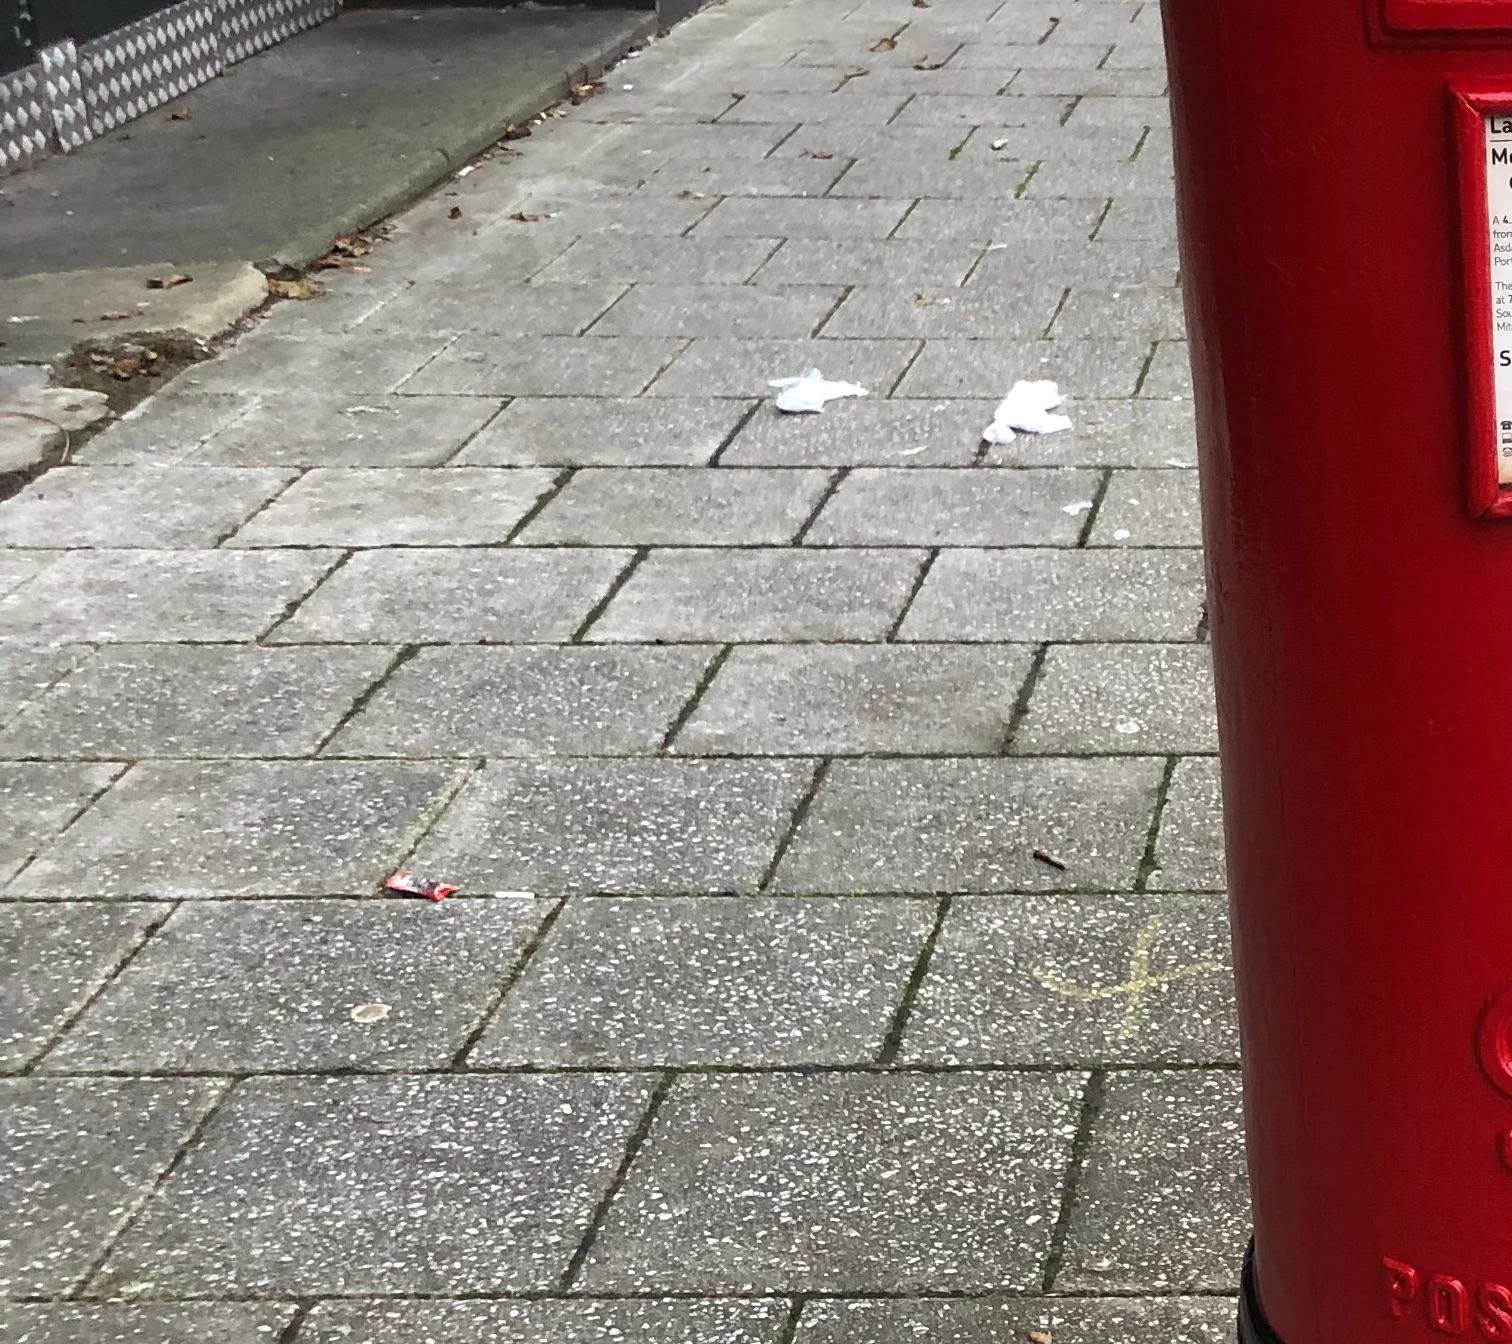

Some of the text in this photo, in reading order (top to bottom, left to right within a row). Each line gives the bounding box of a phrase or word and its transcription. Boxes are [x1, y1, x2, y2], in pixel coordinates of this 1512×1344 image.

[1492, 215, 1500, 225] A
[1495, 280, 1512, 291] The
[1495, 295, 1505, 305] at
